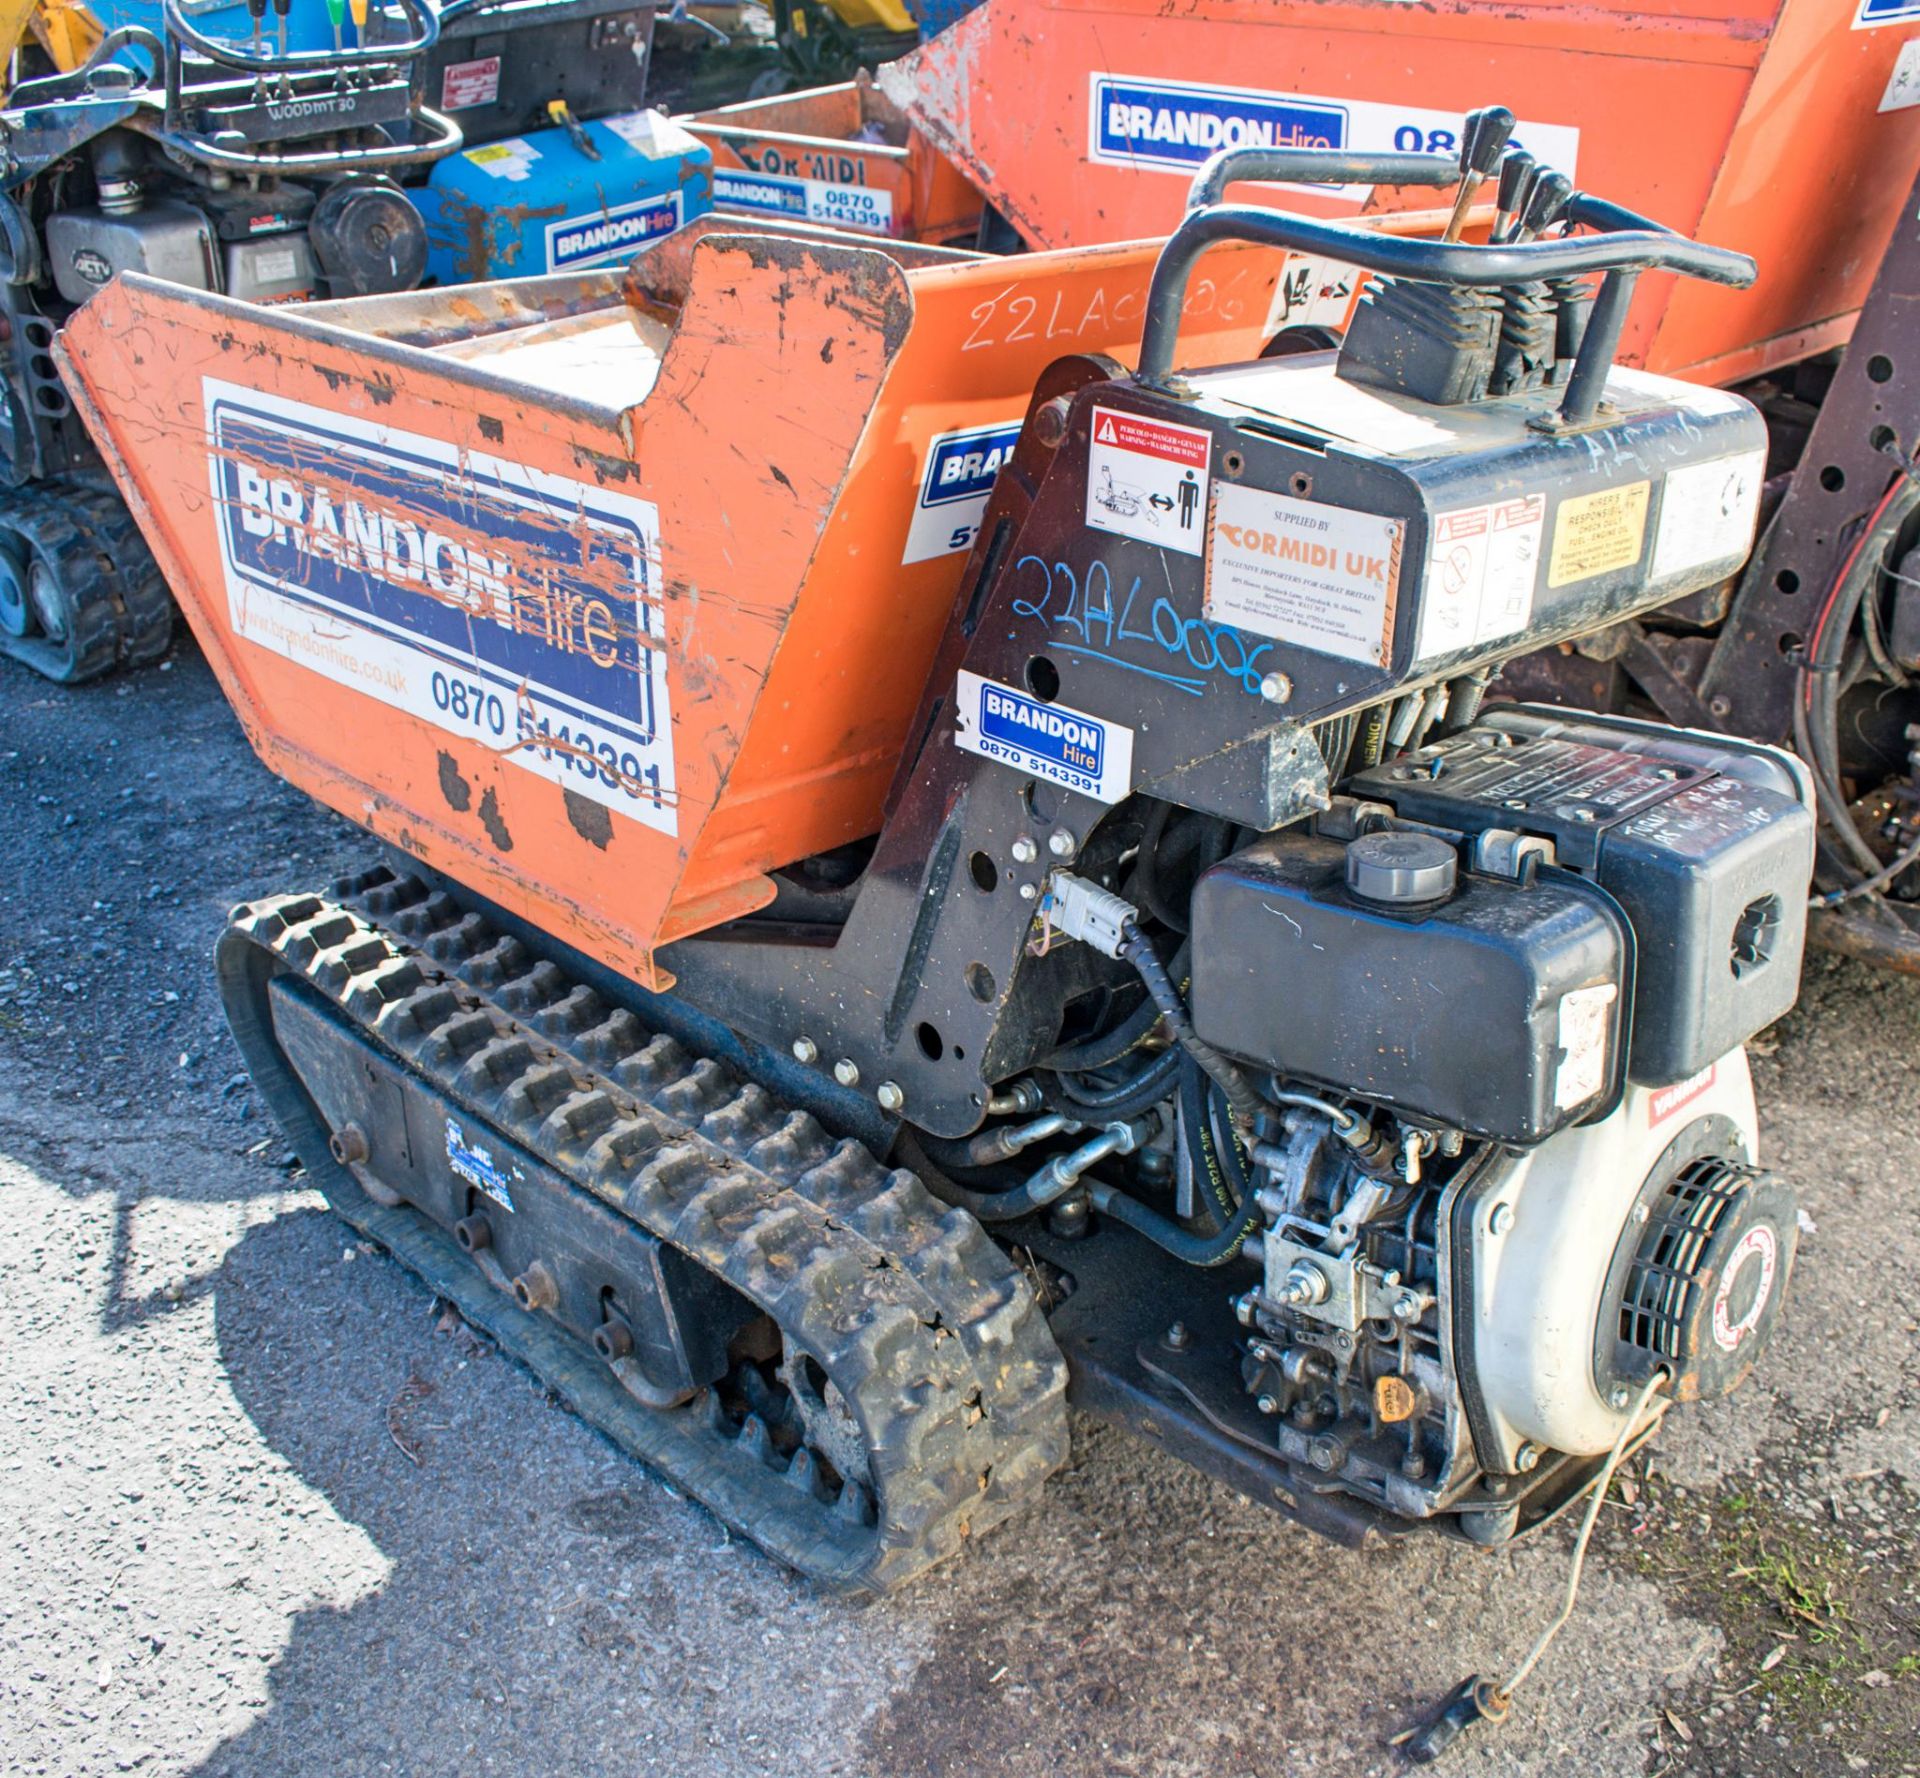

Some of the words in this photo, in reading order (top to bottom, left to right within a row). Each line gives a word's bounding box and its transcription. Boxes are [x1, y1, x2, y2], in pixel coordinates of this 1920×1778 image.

[1108, 102, 1273, 149] BRANDON
[713, 178, 781, 204] BRANDON
[825, 189, 875, 210] 0870
[557, 215, 646, 257] BRANDON
[647, 211, 674, 232] Hire
[812, 204, 891, 229] 5143391
[948, 526, 980, 548] 5
[1273, 511, 1312, 528] SUPPLIED
[1313, 518, 1331, 532] BY
[236, 460, 514, 631] BRANDON
[1217, 522, 1338, 571] CORMIDI
[1346, 551, 1385, 582] UK
[1320, 580, 1344, 595] GREAT
[986, 692, 1097, 752] BRANDON
[432, 671, 504, 736] 0870
[517, 708, 662, 810] 5143391
[1062, 743, 1096, 770] Hire
[979, 739, 1021, 763] 0870
[1029, 759, 1101, 795] 5143391
